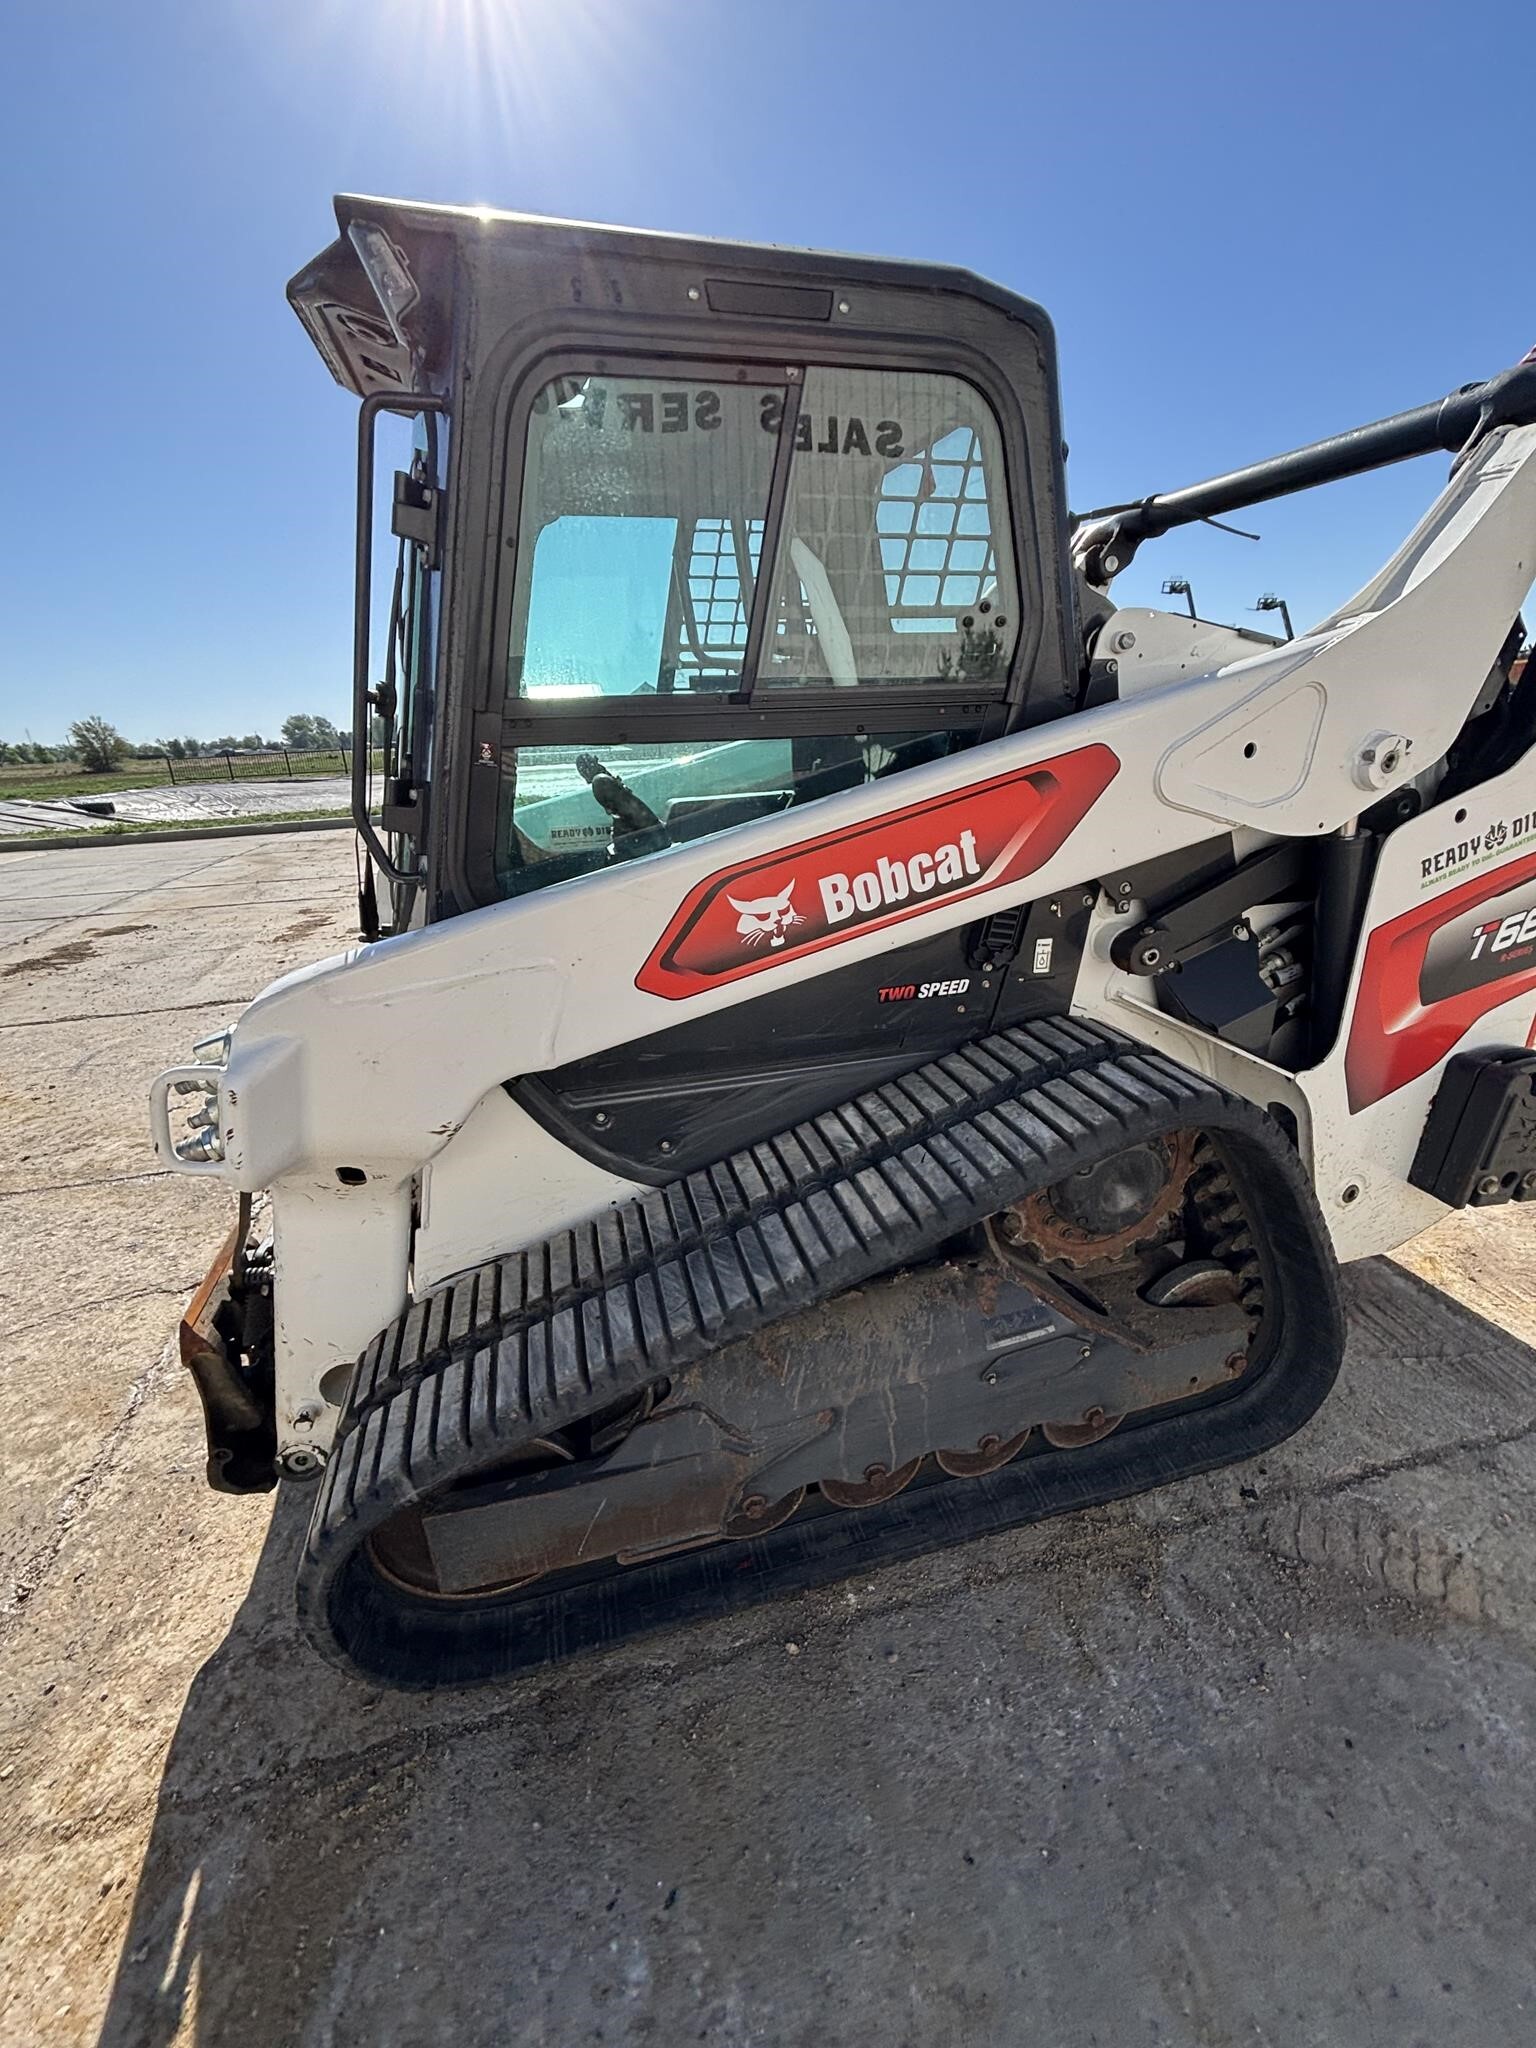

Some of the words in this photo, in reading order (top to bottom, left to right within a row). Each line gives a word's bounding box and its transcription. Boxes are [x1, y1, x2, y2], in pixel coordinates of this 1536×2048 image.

[551, 828, 581, 839] READY
[1421, 835, 1481, 878] READY
[818, 829, 981, 925] Bobcat
[1420, 872, 1447, 890] ALWAYS
[1447, 862, 1471, 878] READY
[1471, 857, 1481, 867] TO
[879, 985, 916, 1002] TWO
[918, 979, 970, 999] SPEED
